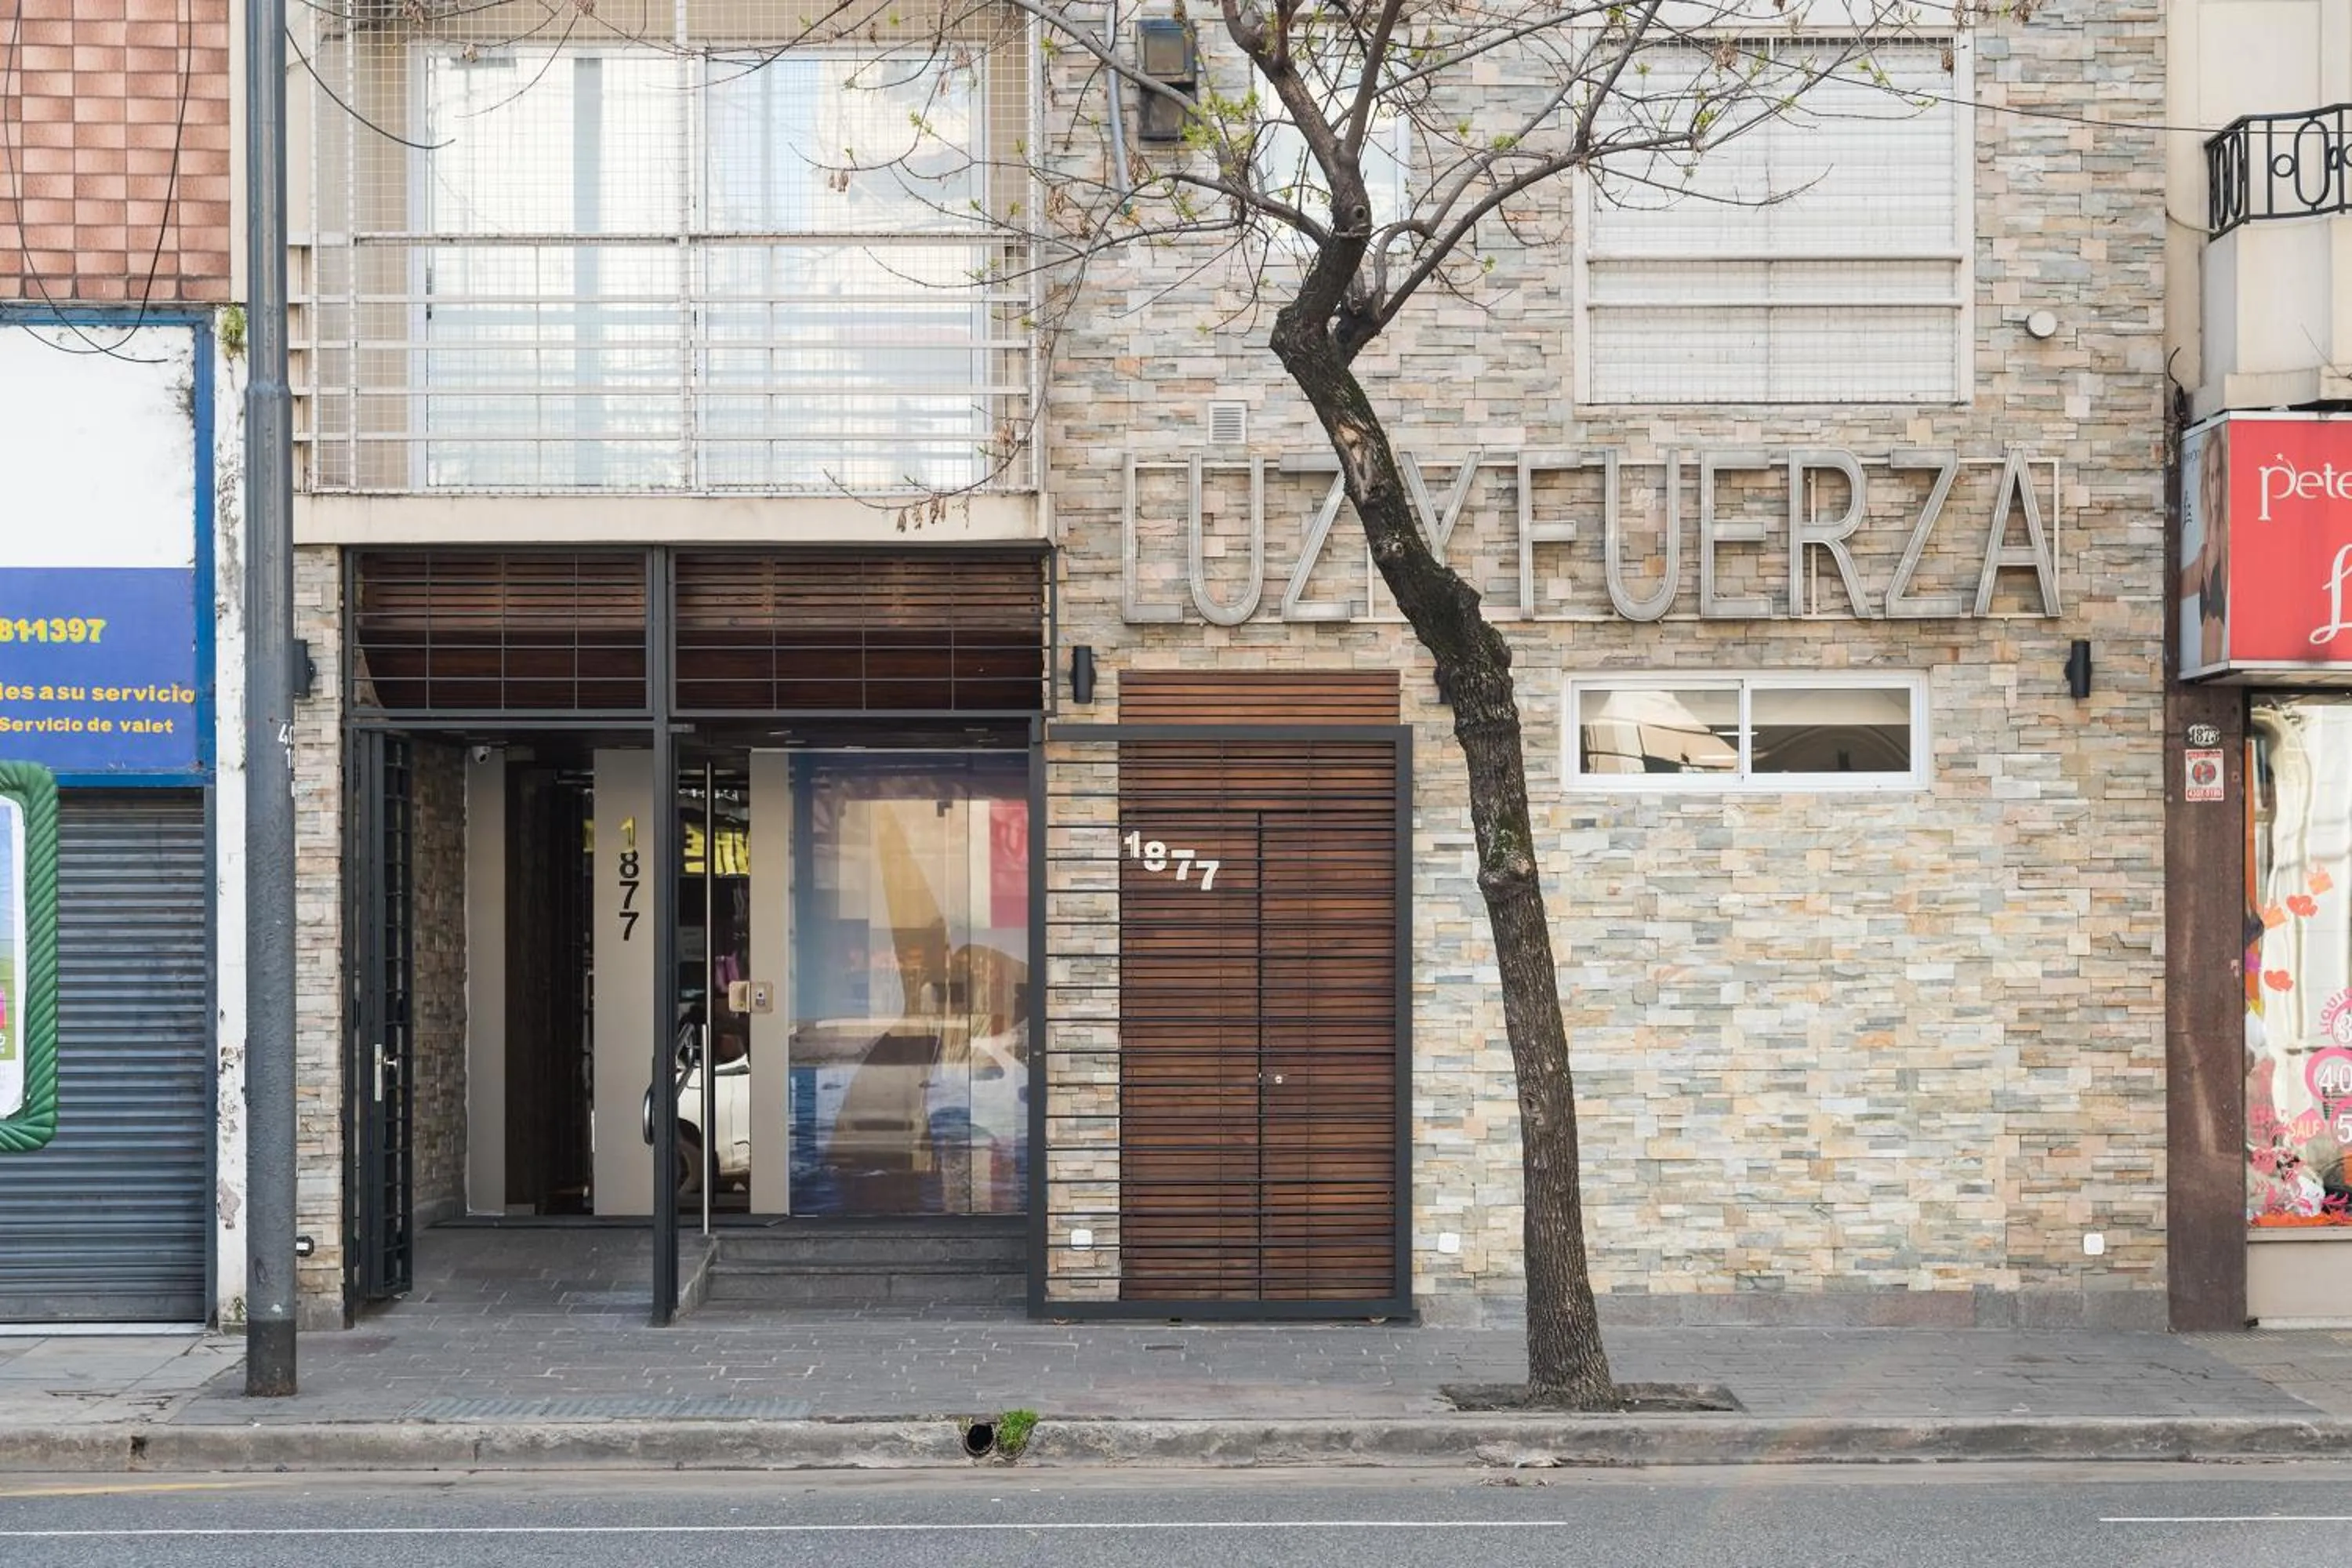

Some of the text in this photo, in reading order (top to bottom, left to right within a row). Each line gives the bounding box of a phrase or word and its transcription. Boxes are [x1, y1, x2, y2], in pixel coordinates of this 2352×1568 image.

[1122, 445, 2063, 626] LUZ Y FUERZA
[91, 683, 196, 703] servicio
[0, 717, 174, 734] Servicio de valet
[619, 815, 640, 942] 1877
[1123, 829, 1220, 891] 1877
